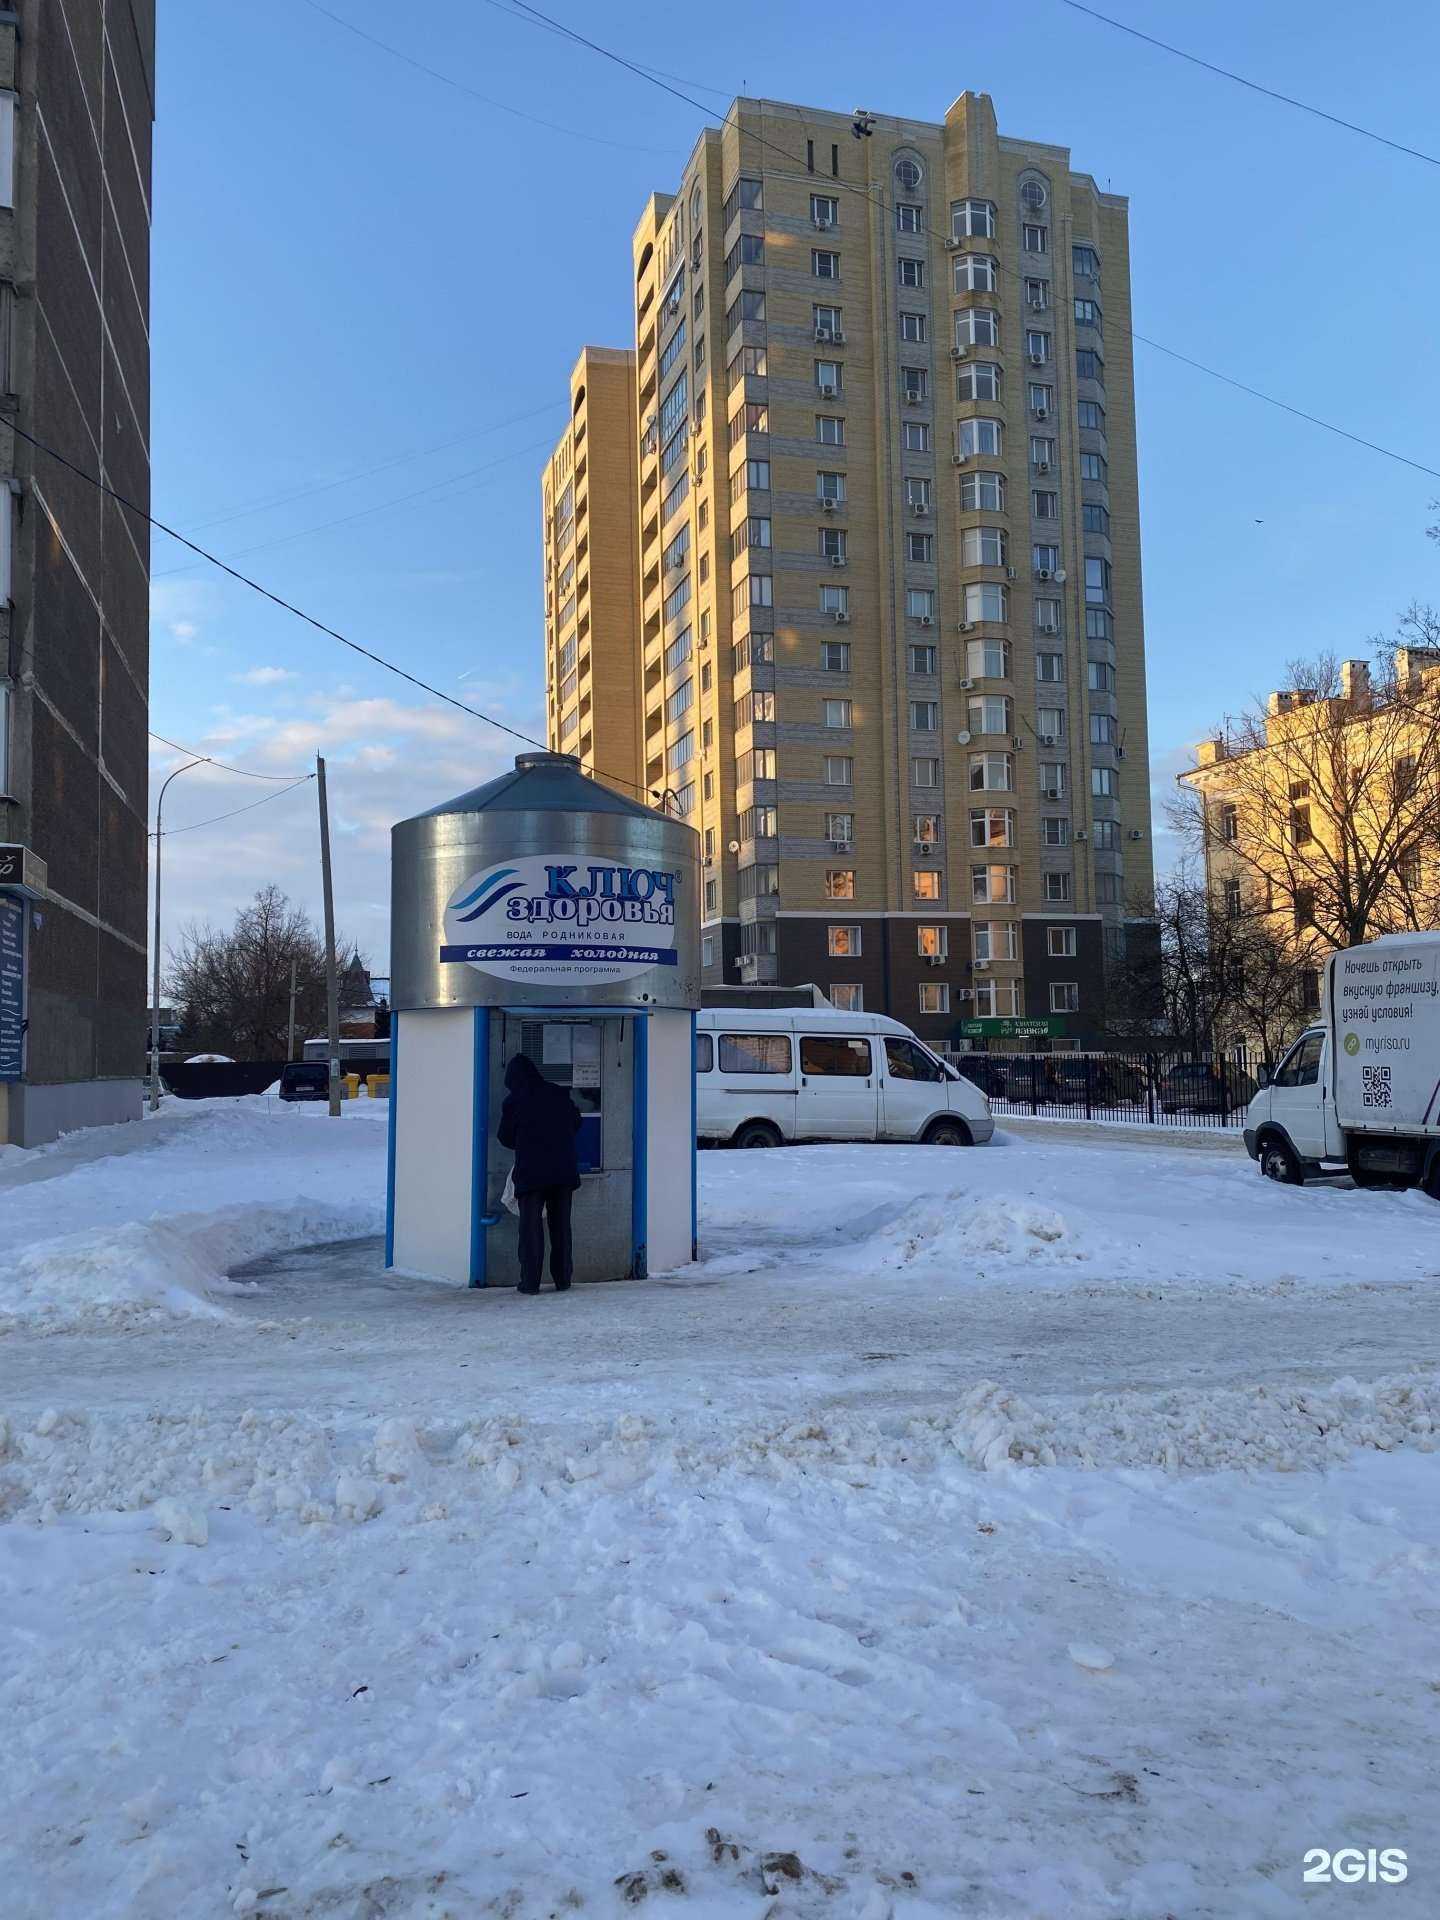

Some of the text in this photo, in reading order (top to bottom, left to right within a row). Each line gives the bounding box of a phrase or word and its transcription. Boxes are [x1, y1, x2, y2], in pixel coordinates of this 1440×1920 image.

[506, 896, 675, 926] здоровья
[506, 930, 626, 941] ВОДА РОДНИКОВАЯ
[467, 947, 659, 961] свежая холодная
[510, 964, 621, 976] Федеральная программа
[1344, 958, 1422, 975] Хочешь открыть
[1343, 980, 1439, 1000] вкусную франшизу,
[1342, 1003, 1413, 1024] узнай условия!
[1365, 1036, 1410, 1053] myriso.ru
